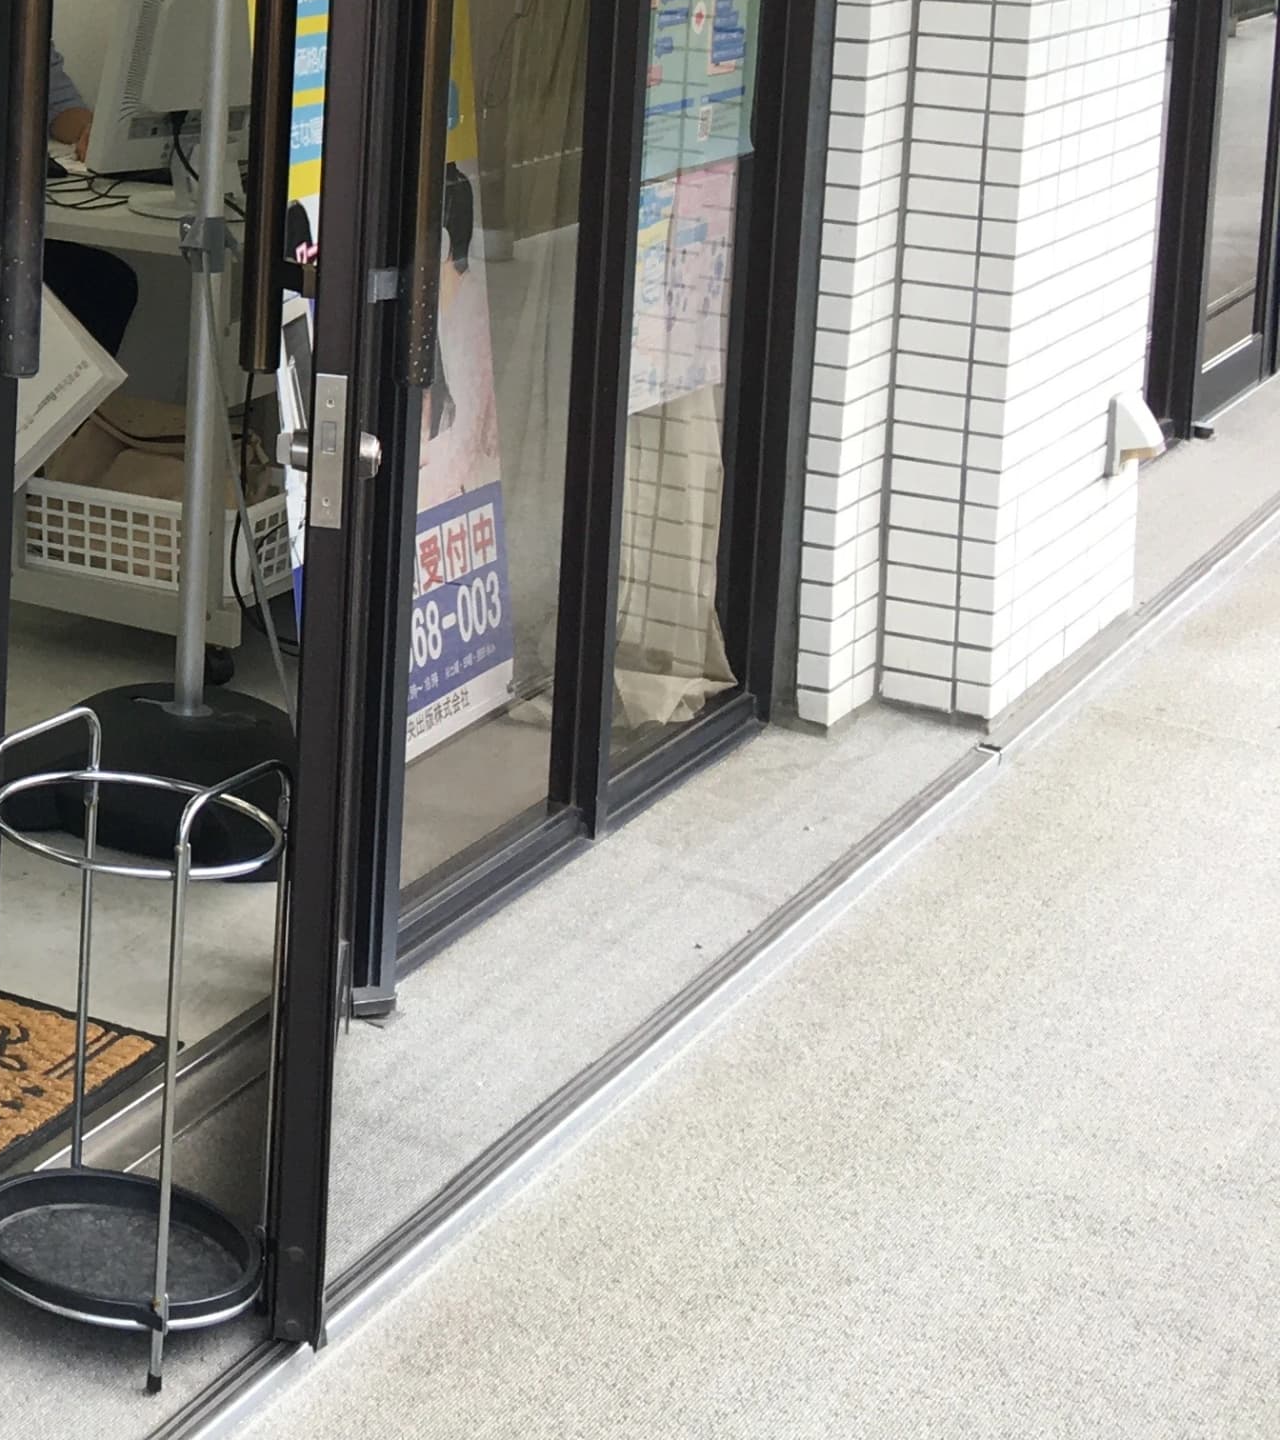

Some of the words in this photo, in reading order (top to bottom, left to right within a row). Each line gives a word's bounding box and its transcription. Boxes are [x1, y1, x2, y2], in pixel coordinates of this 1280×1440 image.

[419, 513, 494, 592] 受付中
[410, 571, 502, 672] 68-003
